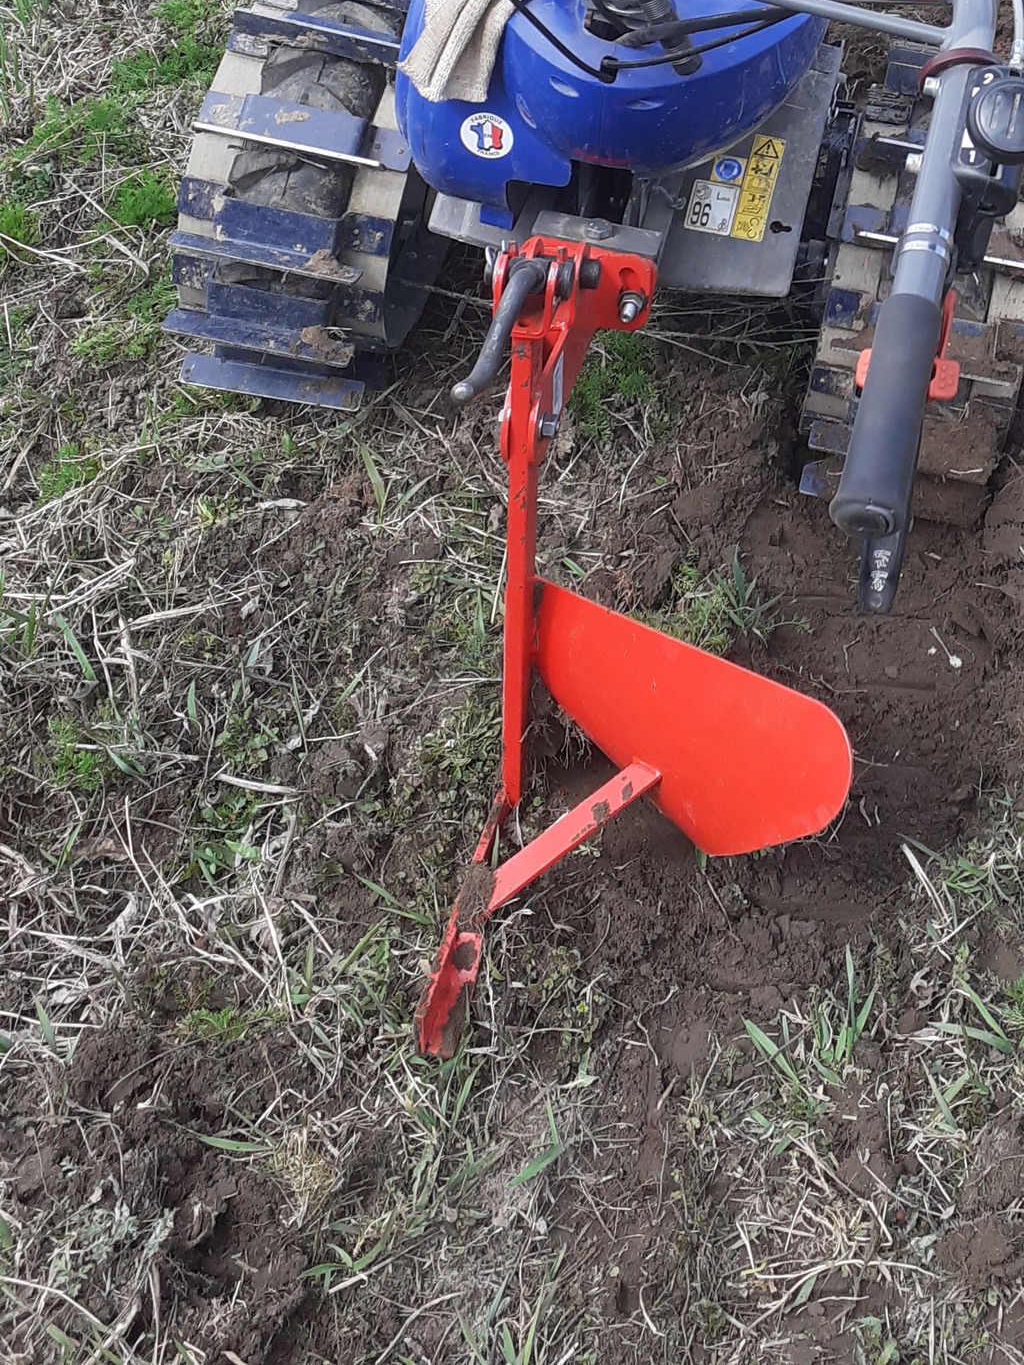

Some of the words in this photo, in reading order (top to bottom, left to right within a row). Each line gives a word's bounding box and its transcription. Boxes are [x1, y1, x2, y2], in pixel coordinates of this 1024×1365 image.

[983, 73, 994, 85] 2
[470, 114, 503, 125] FABRIQUE
[477, 149, 501, 157] FRANCE
[968, 150, 976, 163] 1
[690, 201, 711, 226] 96
